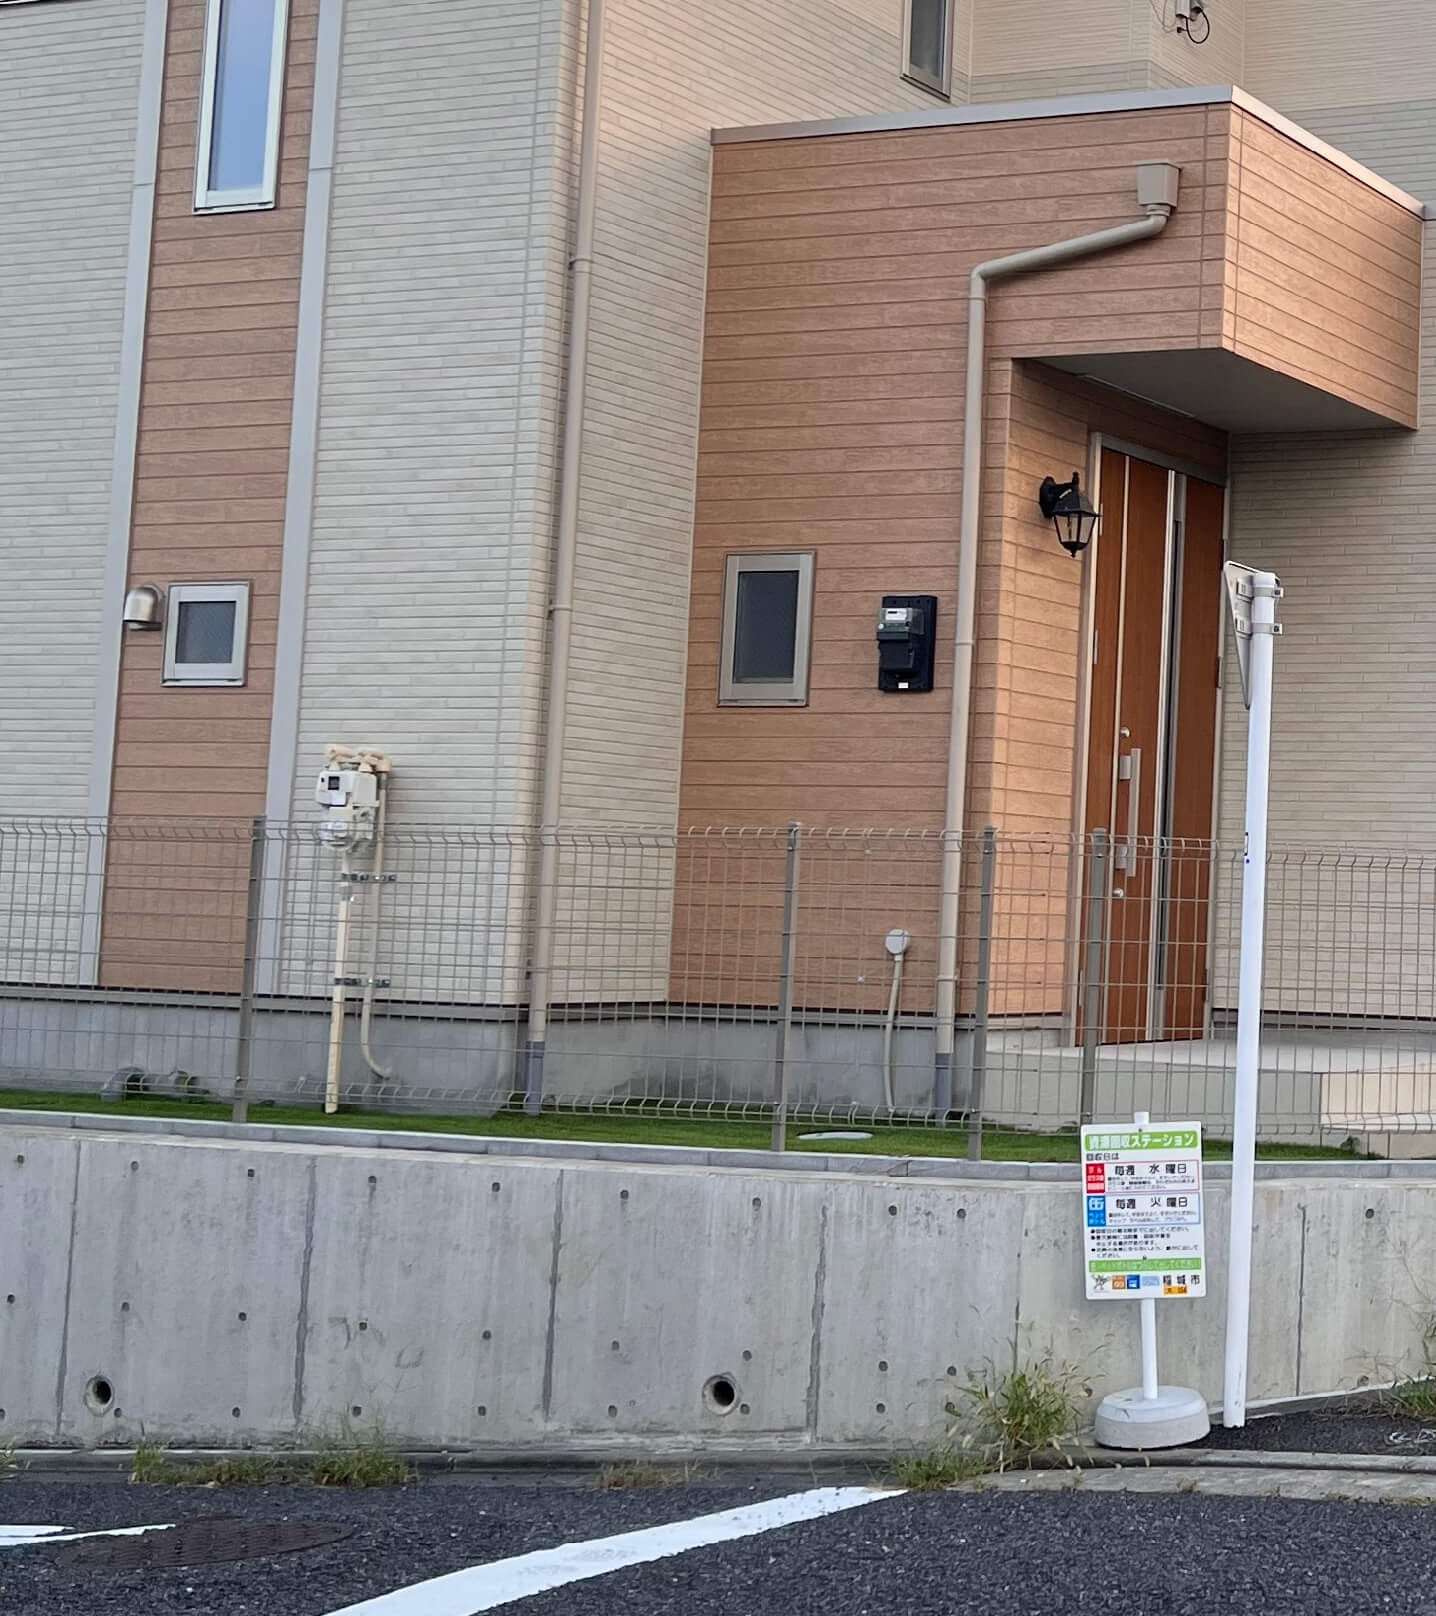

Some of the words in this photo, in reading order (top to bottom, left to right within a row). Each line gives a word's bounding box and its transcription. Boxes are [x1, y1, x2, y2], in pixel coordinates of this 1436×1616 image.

[1115, 1165, 1135, 1176] 毎週
[1165, 1163, 1187, 1174] 曜日
[1116, 1198, 1136, 1209] 毎週
[1166, 1196, 1188, 1207] 曜日
